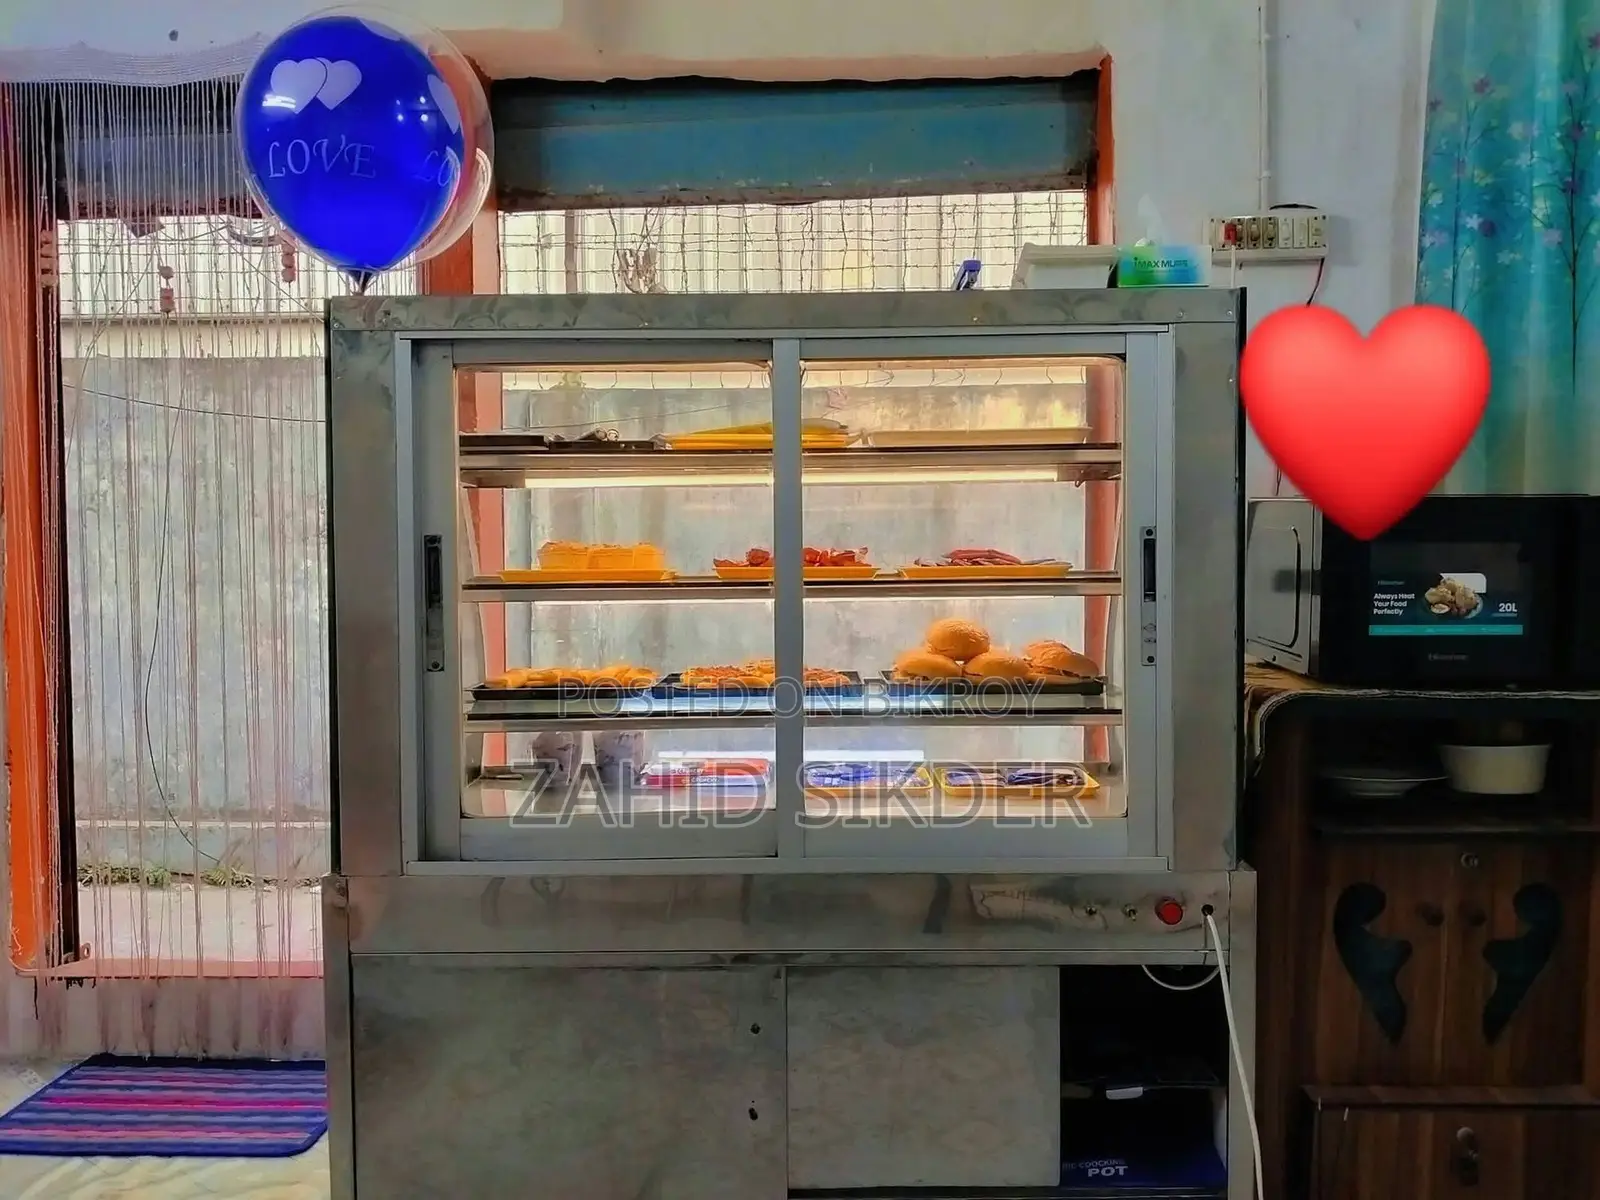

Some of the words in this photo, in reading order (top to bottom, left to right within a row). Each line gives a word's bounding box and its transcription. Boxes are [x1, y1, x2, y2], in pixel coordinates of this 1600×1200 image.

[268, 135, 376, 179] LOVE
[1373, 592, 1398, 601] Always
[1398, 592, 1416, 600] Heat
[1373, 600, 1390, 608] Your
[1390, 600, 1408, 608] Food
[1498, 602, 1518, 613] 20L
[1373, 607, 1404, 616] Perfectly
[1087, 1165, 1128, 1178] POT
